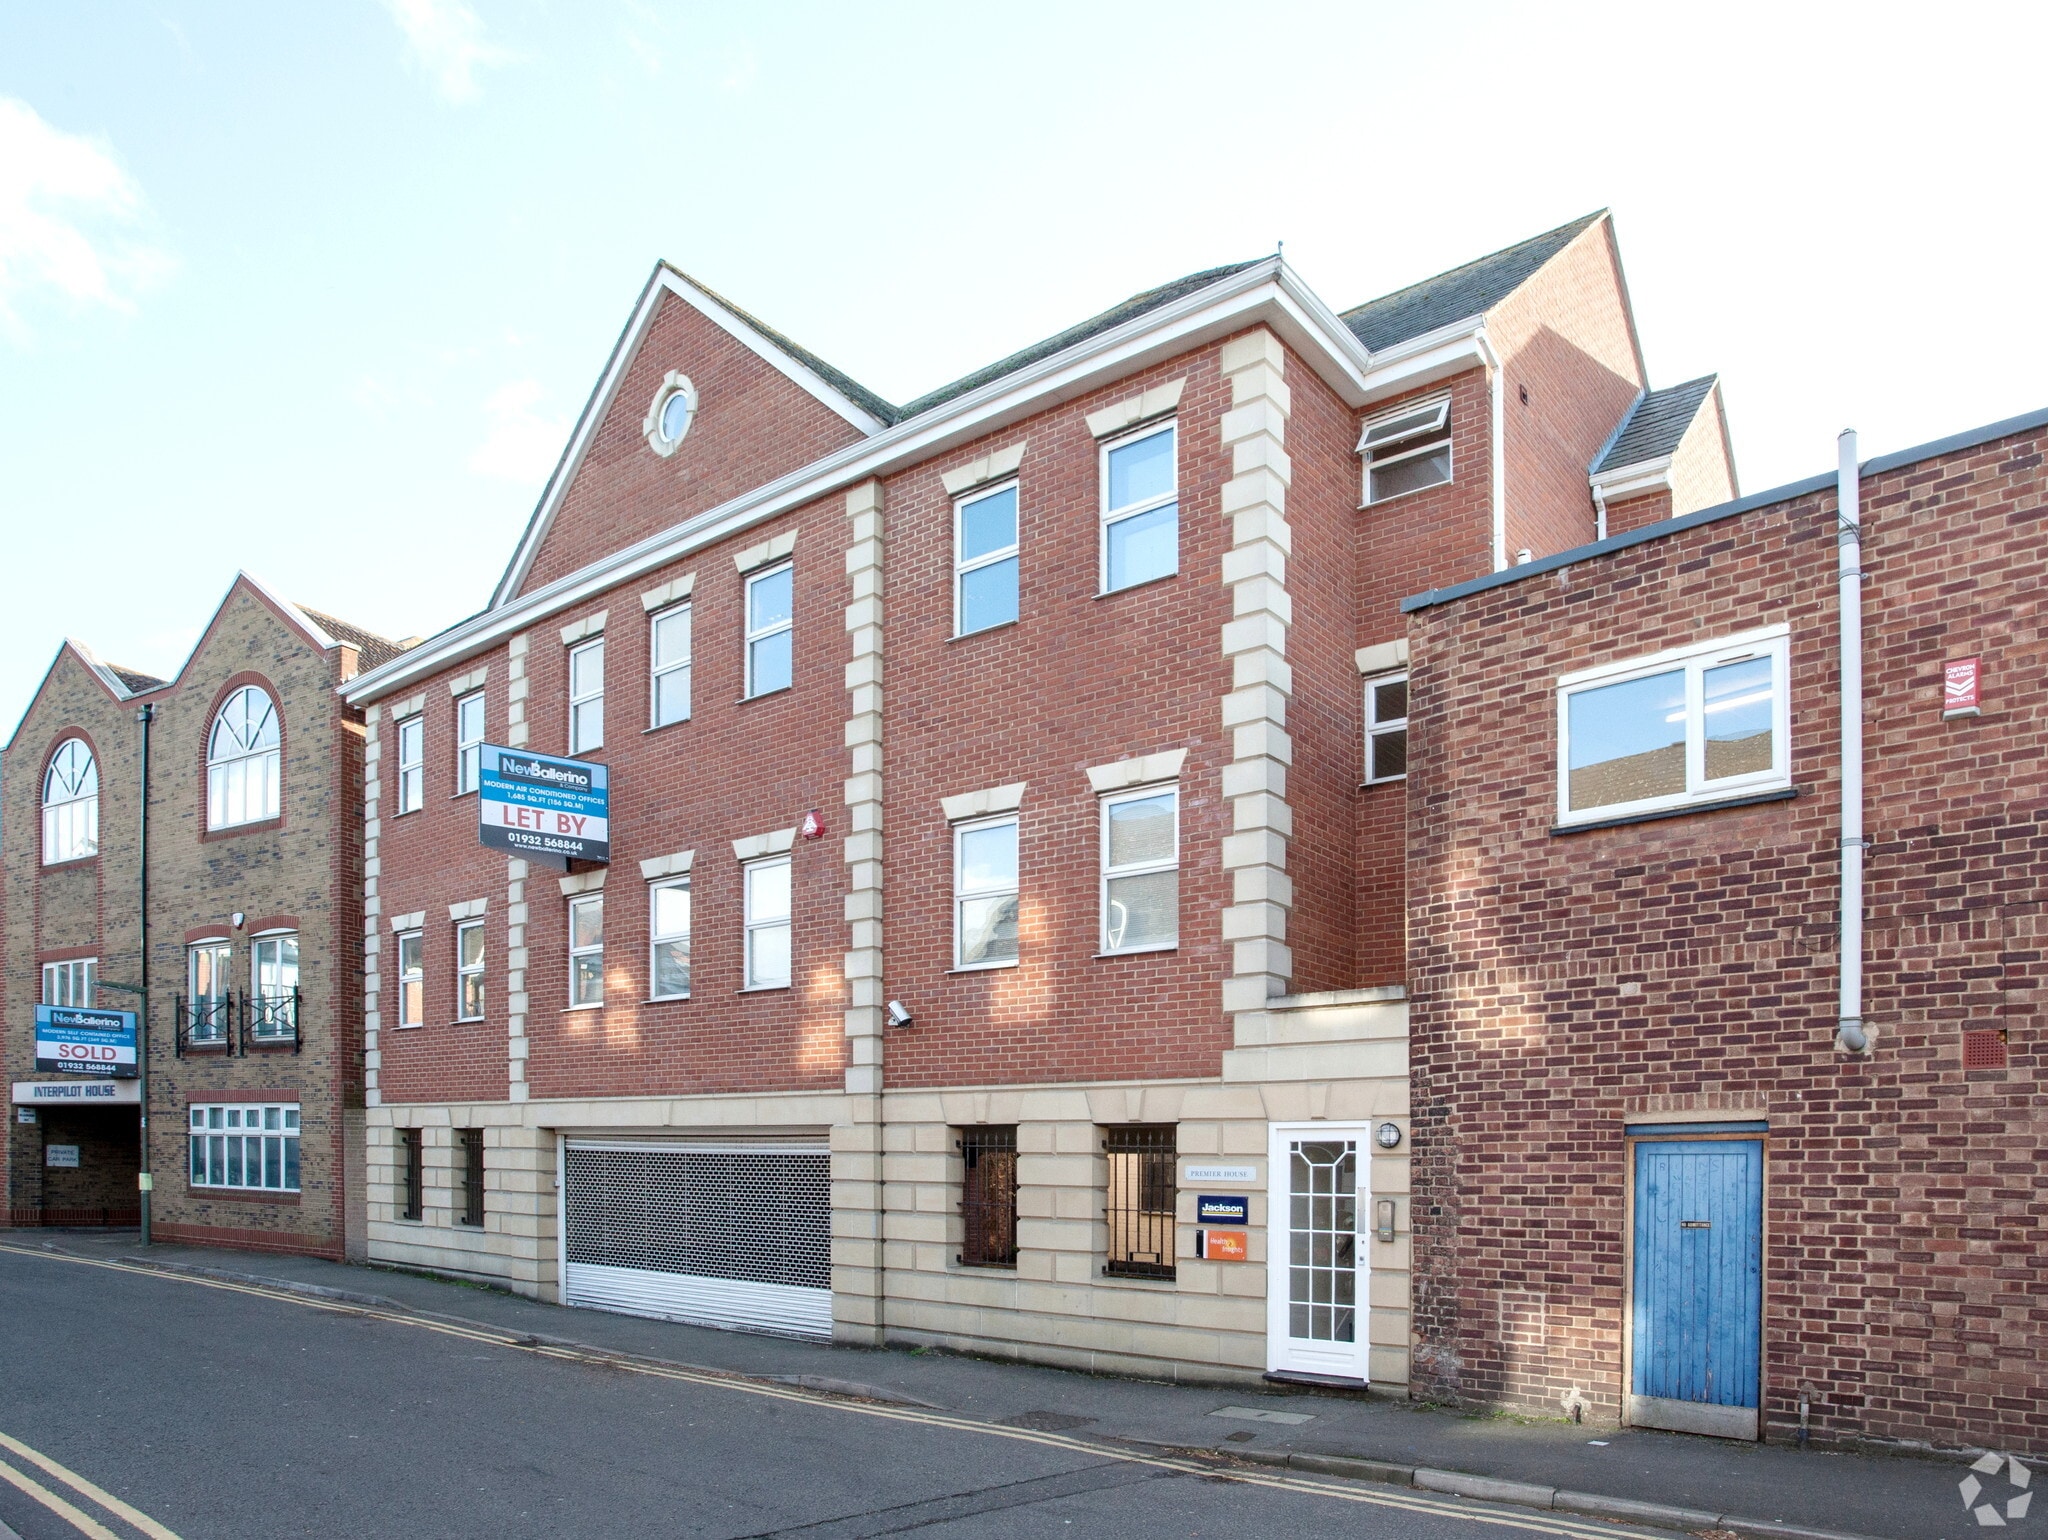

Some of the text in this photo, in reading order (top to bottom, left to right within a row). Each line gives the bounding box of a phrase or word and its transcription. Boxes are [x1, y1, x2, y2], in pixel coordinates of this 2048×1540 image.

[1946, 664, 1975, 674] CHEVRON
[1948, 670, 1973, 679] ALARMS
[1946, 695, 1974, 704] PROTECTS
[484, 780, 605, 805] MODERN AIR CONDITIONED OFFICES
[564, 784, 588, 792] Company
[507, 792, 584, 810] 1,685 SQ.FT (156 SQ.M)
[503, 805, 587, 836] LET BY
[508, 832, 583, 851] 01932 568844
[514, 843, 578, 856] www.newballerino.co.uk
[58, 1044, 117, 1060] SOLD
[57, 1062, 116, 1071] 01932 568844
[34, 1085, 115, 1097] INTERPILOT HOUSE
[1202, 1203, 1243, 1212] Jackson
[1210, 1237, 1228, 1245] Health
[1222, 1246, 1243, 1254] Insights
